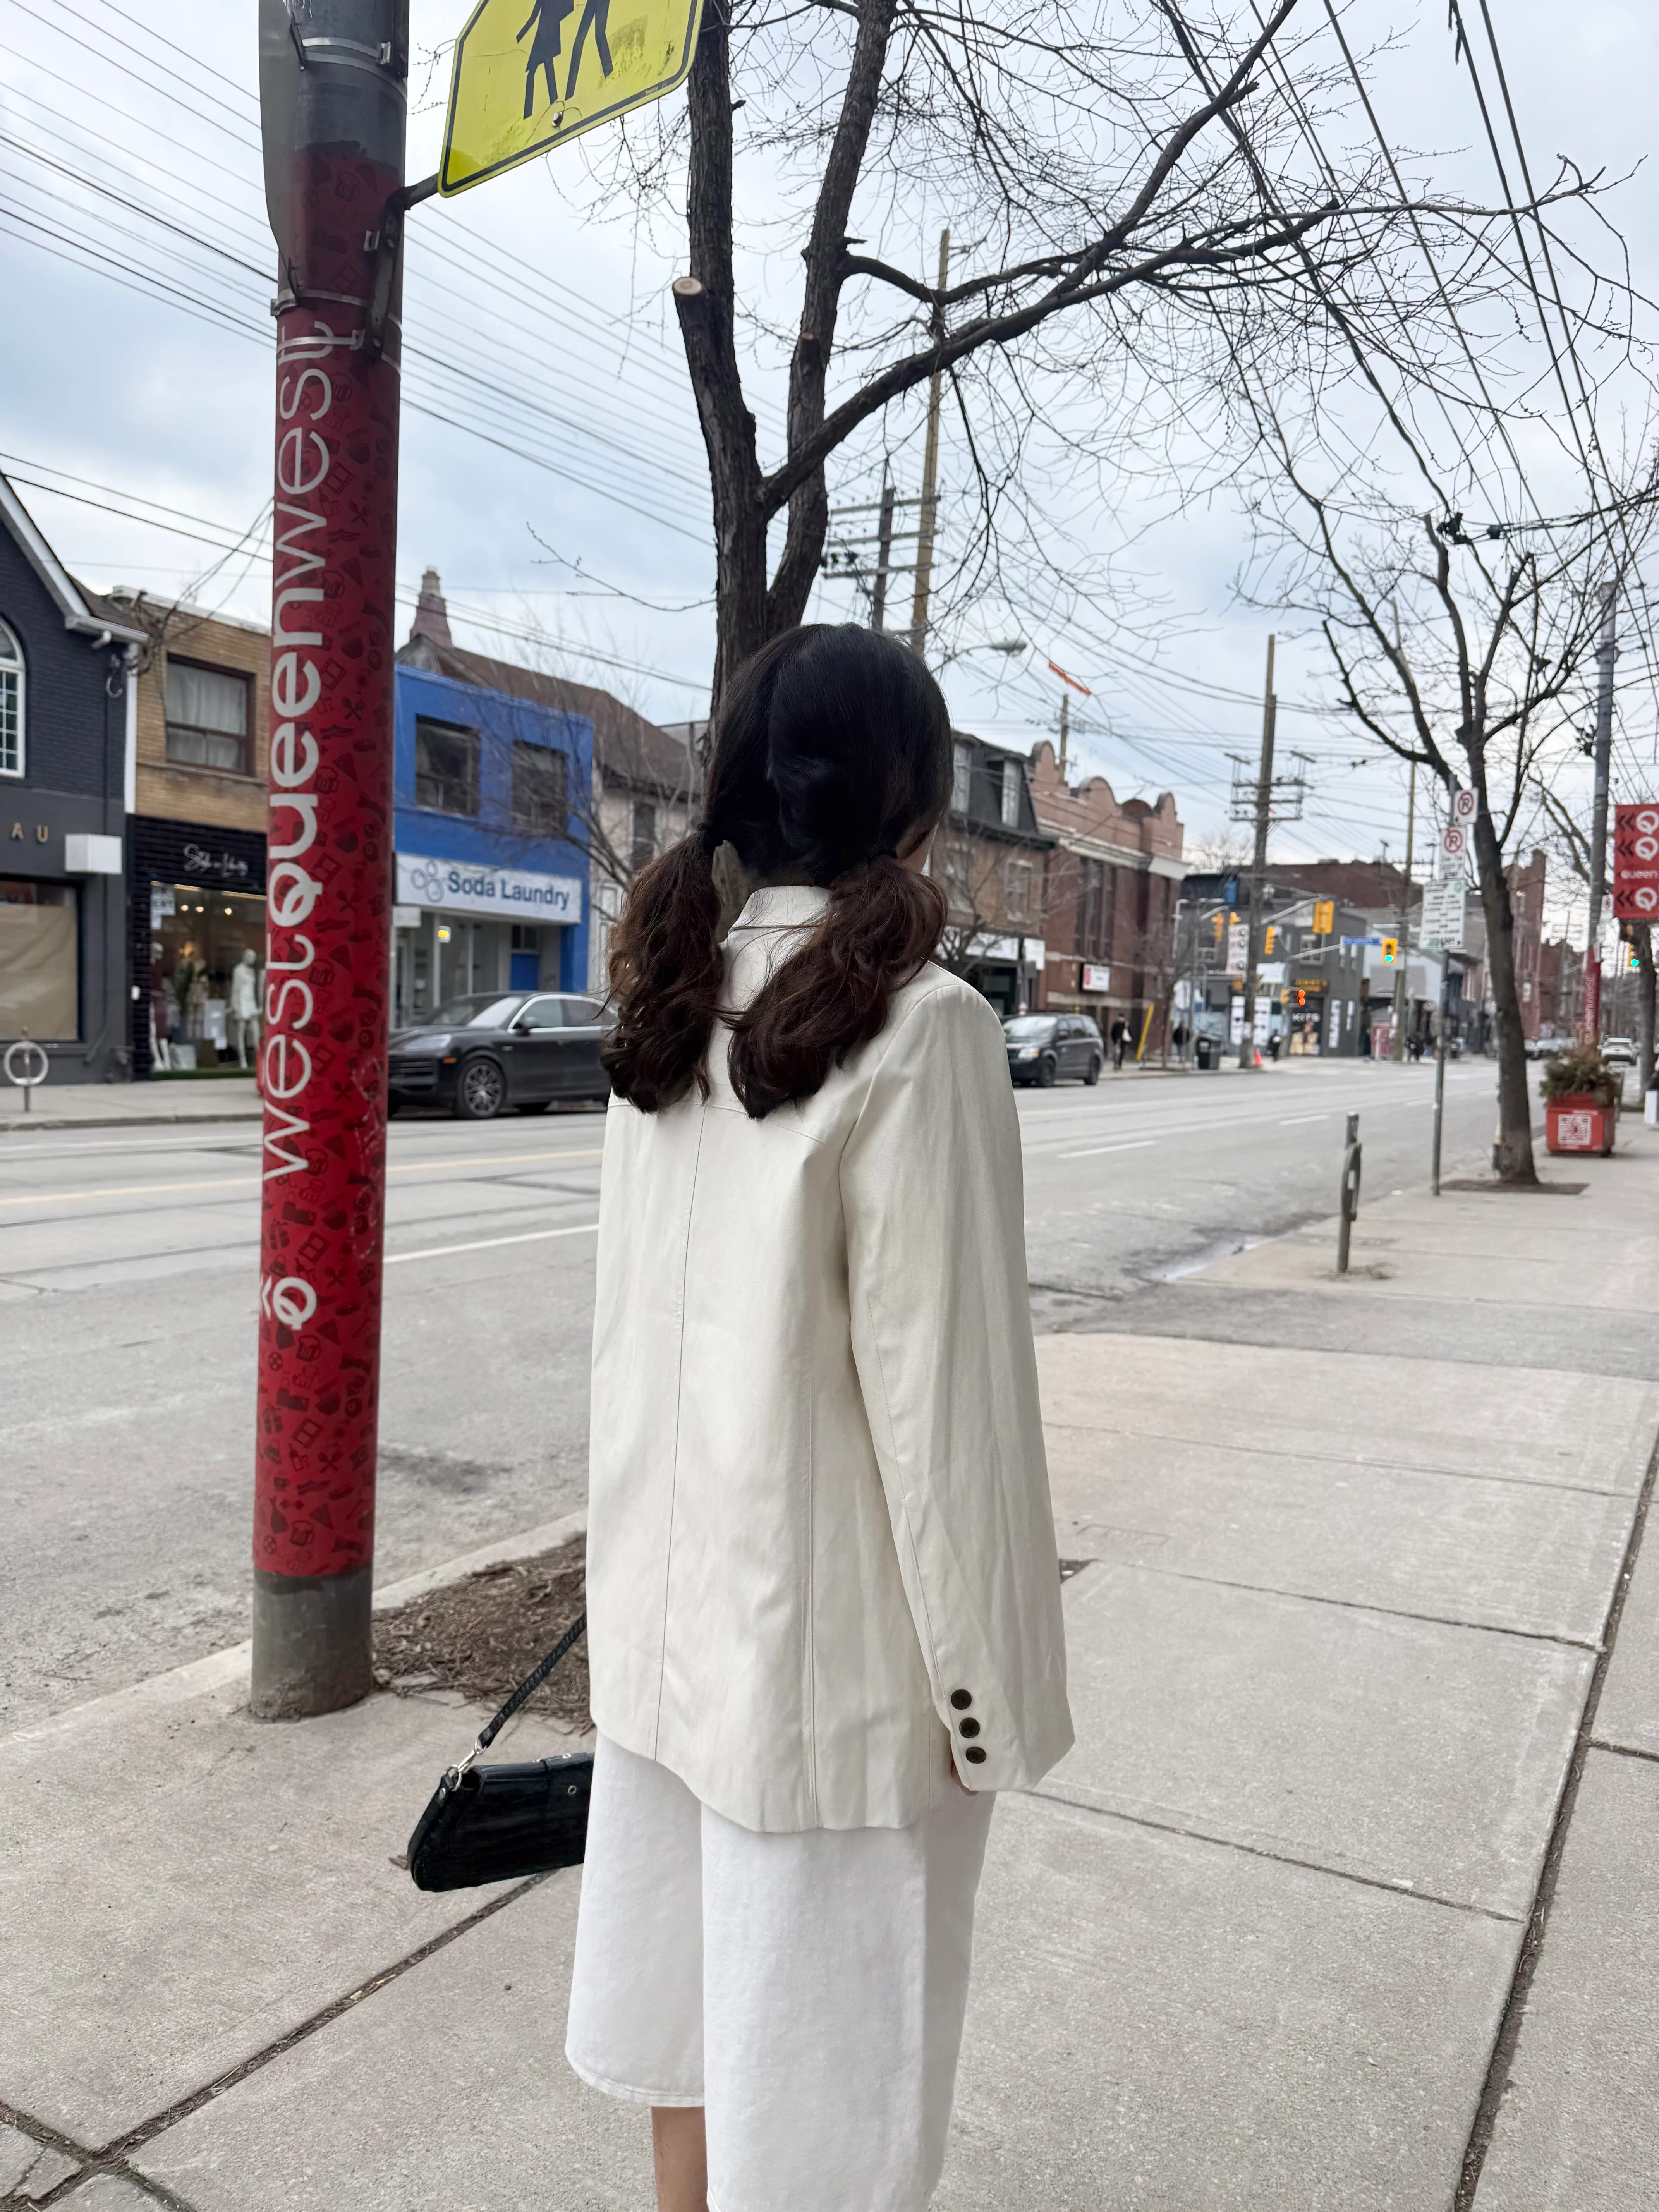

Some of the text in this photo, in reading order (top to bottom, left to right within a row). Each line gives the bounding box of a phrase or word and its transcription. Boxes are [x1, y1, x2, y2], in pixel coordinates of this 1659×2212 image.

[1635, 810, 1659, 835] Q
[1634, 836, 1659, 861] Q
[448, 870, 569, 910] Soda Laundry
[1633, 886, 1657, 912] Q
[273, 1276, 318, 1331] Q
